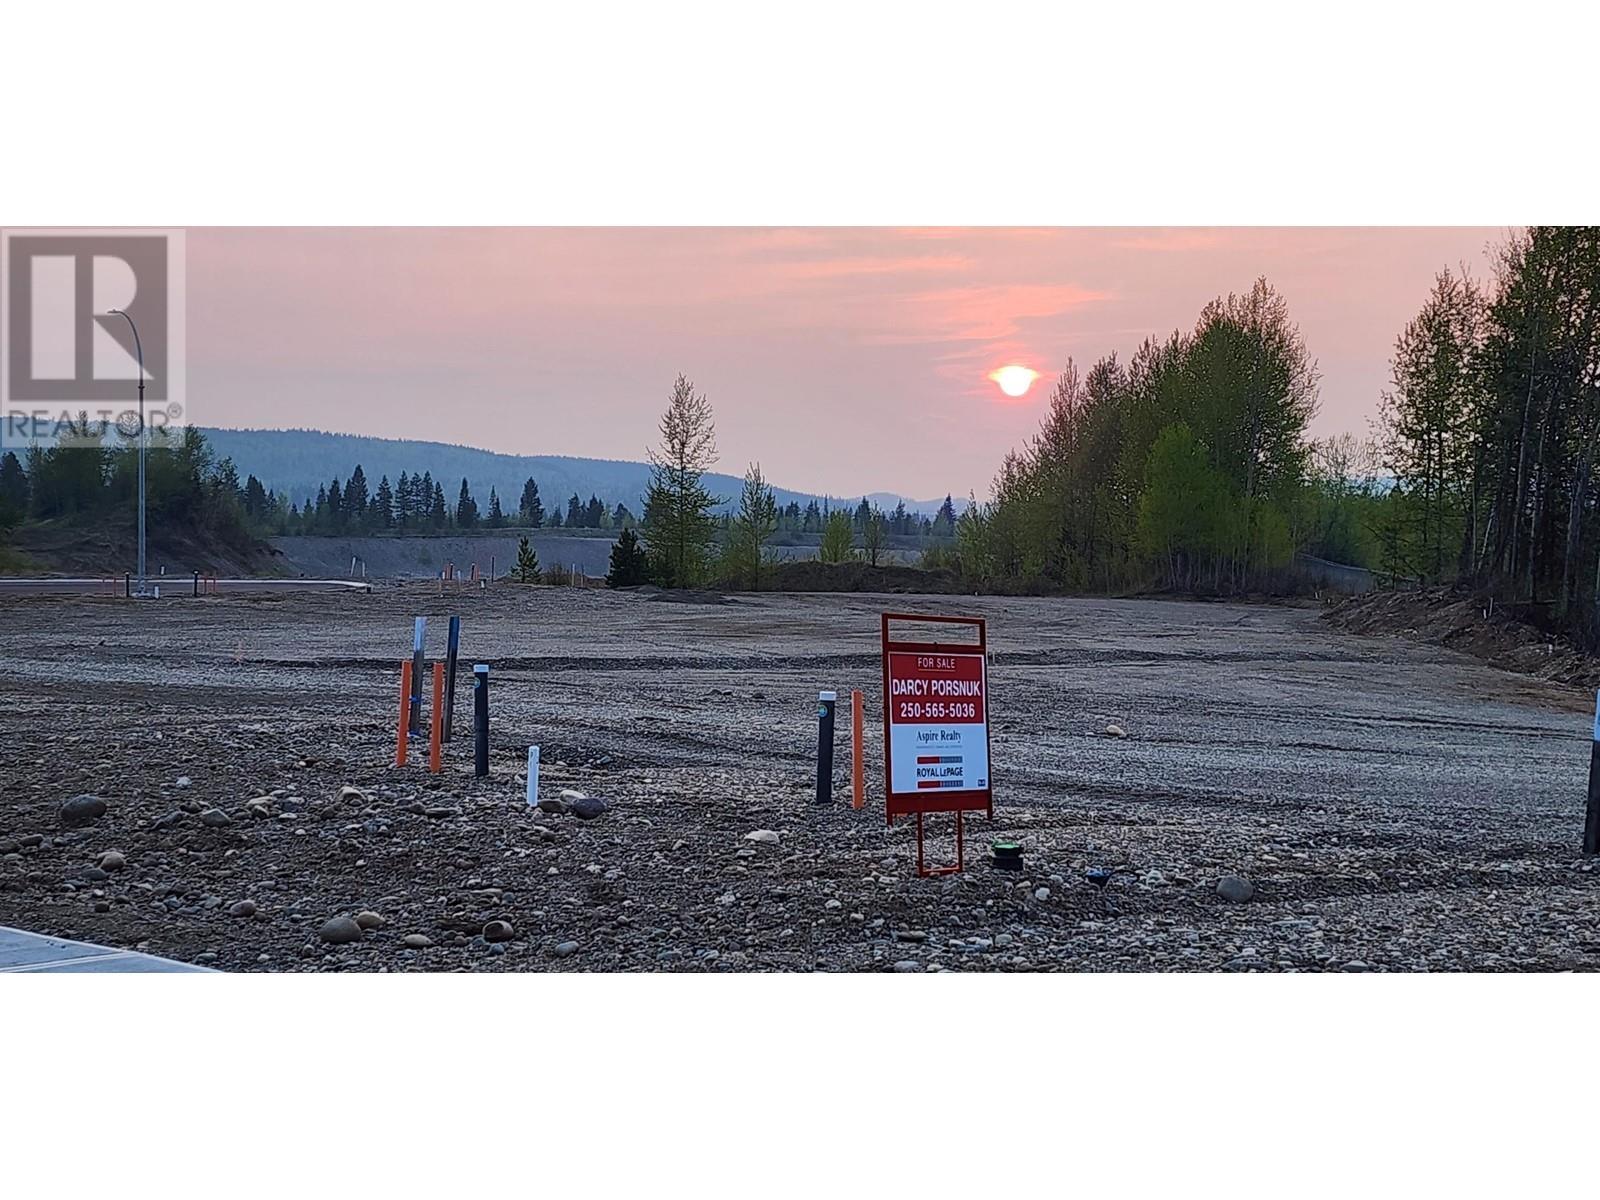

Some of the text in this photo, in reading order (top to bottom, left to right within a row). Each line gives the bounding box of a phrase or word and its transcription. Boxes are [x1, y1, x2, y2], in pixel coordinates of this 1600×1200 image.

[918, 657, 956, 669] FOR SALE
[892, 679, 981, 697] DARCY PORSNUK
[900, 702, 975, 718] 250-565-5036
[917, 730, 961, 744] Aspire Realty
[916, 767, 940, 778] ROYAL
